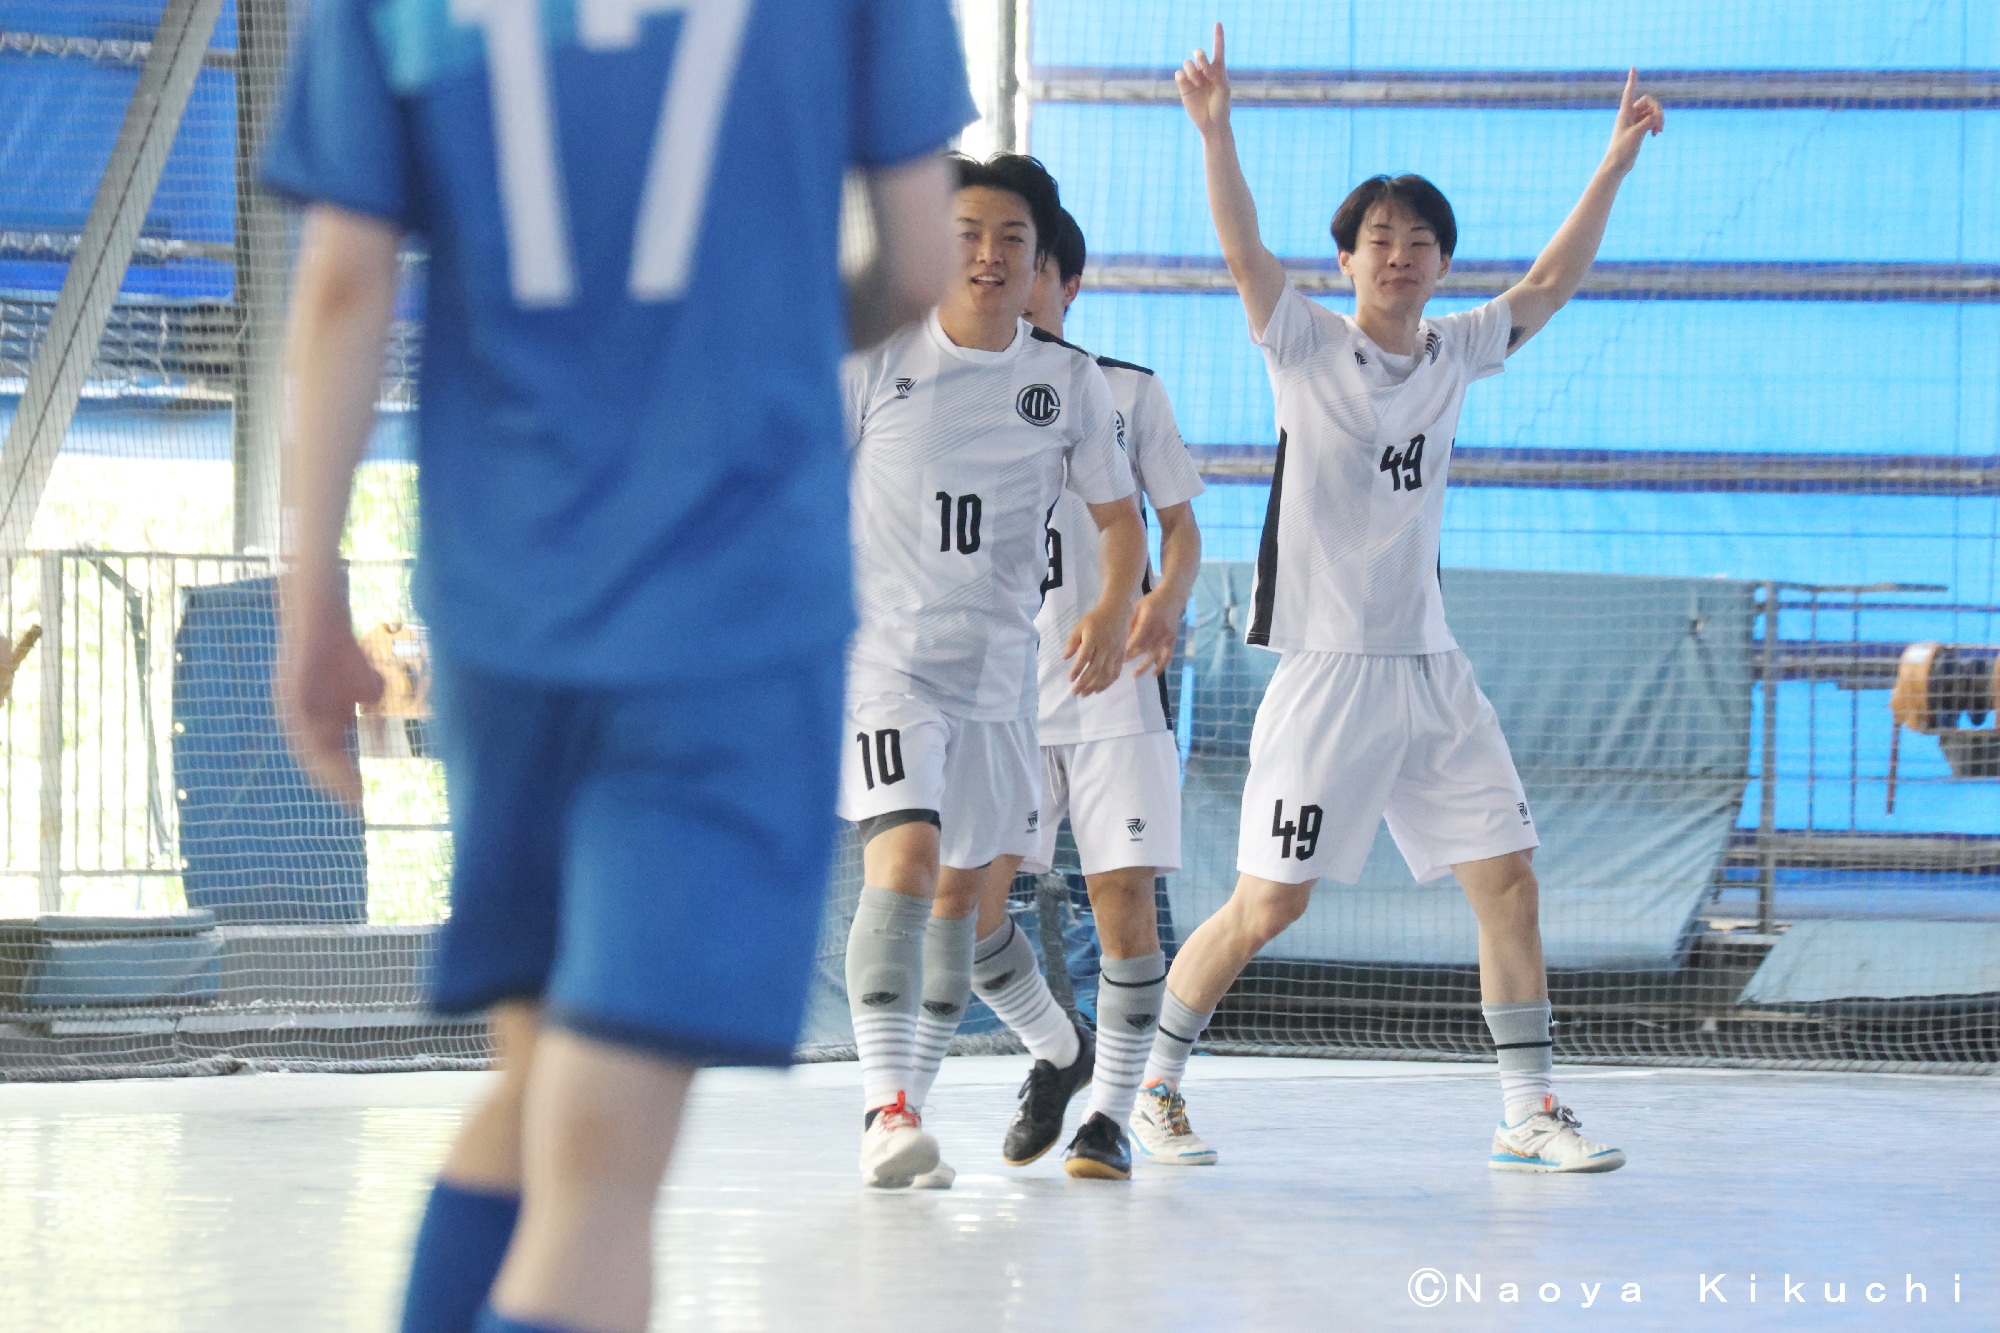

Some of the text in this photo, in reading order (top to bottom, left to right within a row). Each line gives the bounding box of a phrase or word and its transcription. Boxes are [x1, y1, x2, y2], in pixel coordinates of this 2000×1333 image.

[446, 0, 752, 305] 17
[1380, 434, 1425, 491] 49
[936, 491, 982, 555] 10
[857, 728, 905, 791] 10
[1272, 799, 1323, 861] 49
